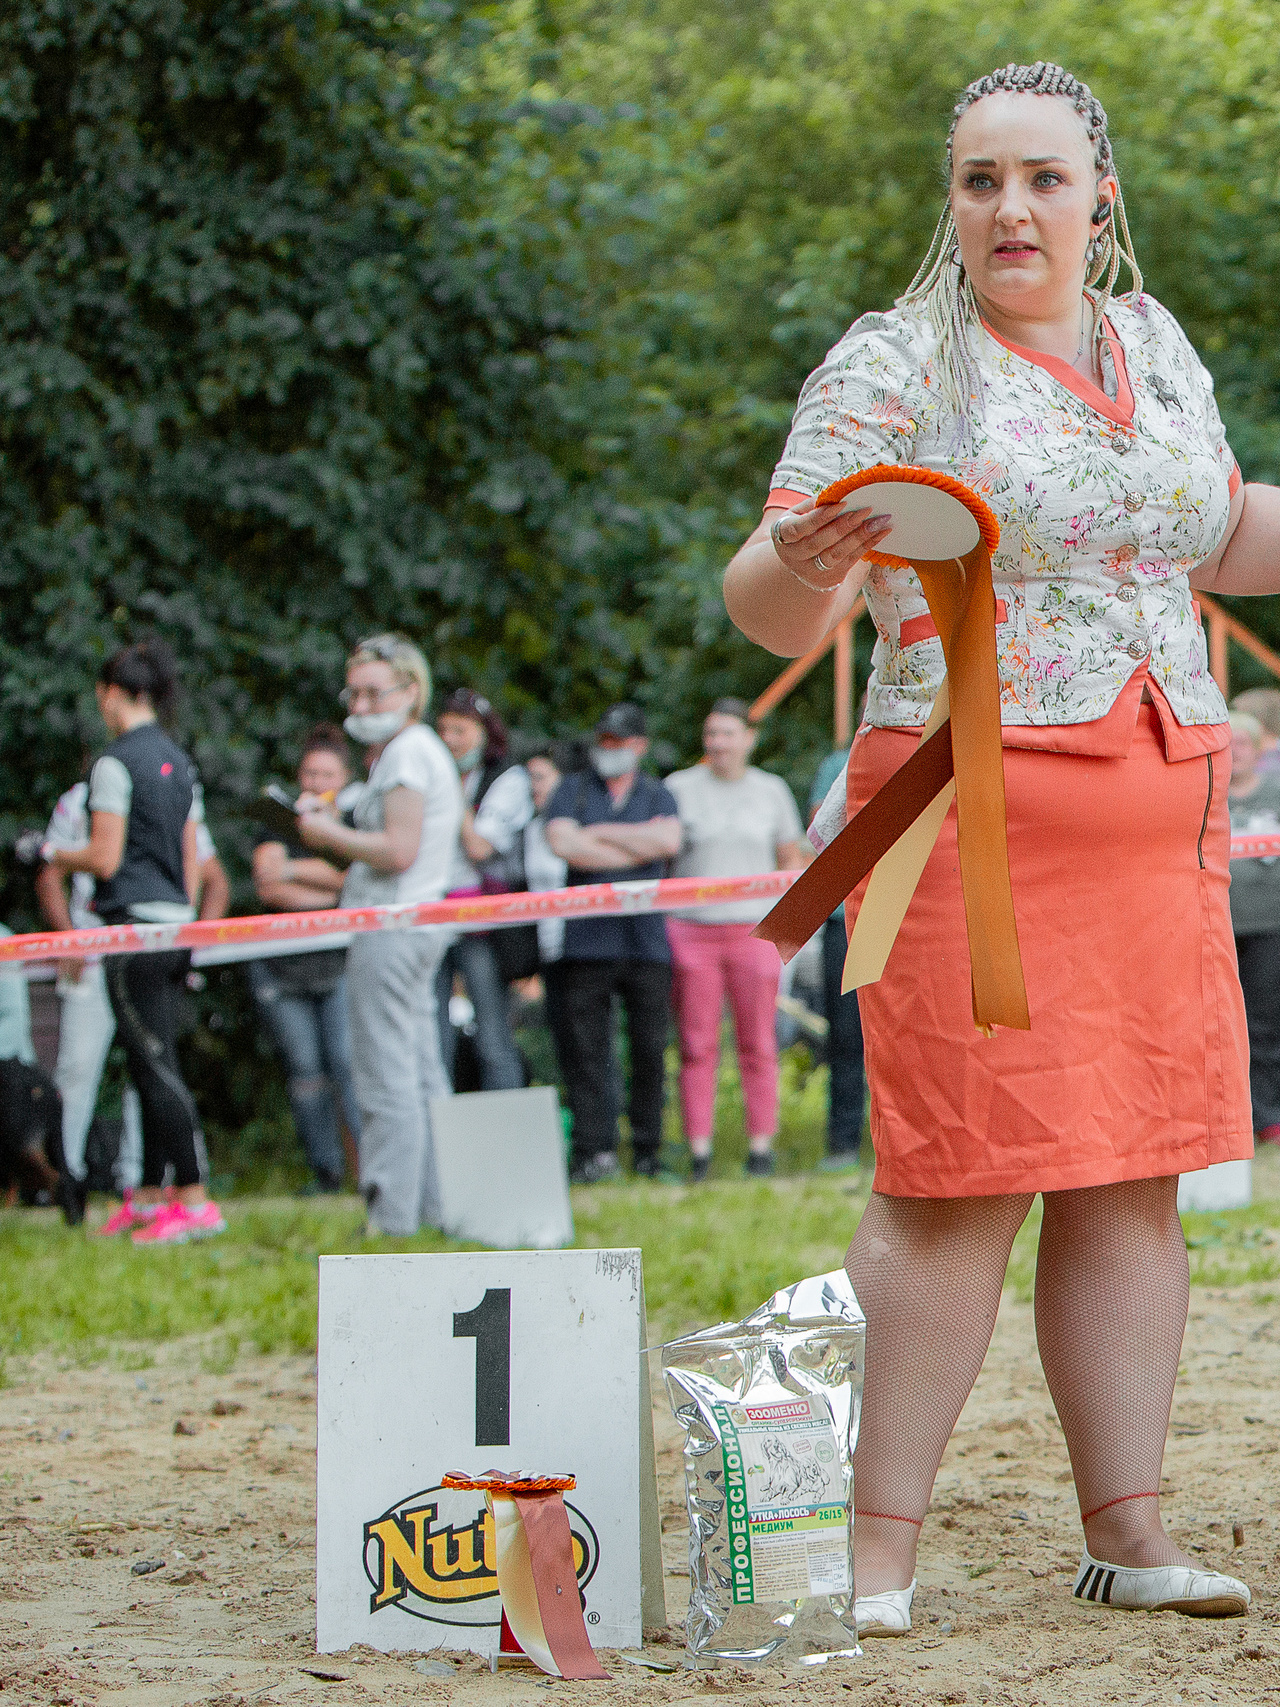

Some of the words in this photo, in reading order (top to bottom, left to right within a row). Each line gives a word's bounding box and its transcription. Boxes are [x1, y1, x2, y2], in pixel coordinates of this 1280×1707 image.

[453, 1288, 511, 1446] 1
[748, 1403, 808, 1419] ЗООМЕНЮ
[714, 1408, 752, 1602] ПРОФЕССИОНАЛ
[750, 1507, 810, 1522] УТКА+ЛОСОСЬ
[819, 1509, 842, 1520] 26/15
[752, 1521, 793, 1533] МЕДИУМ
[365, 1504, 586, 1610] Nut
